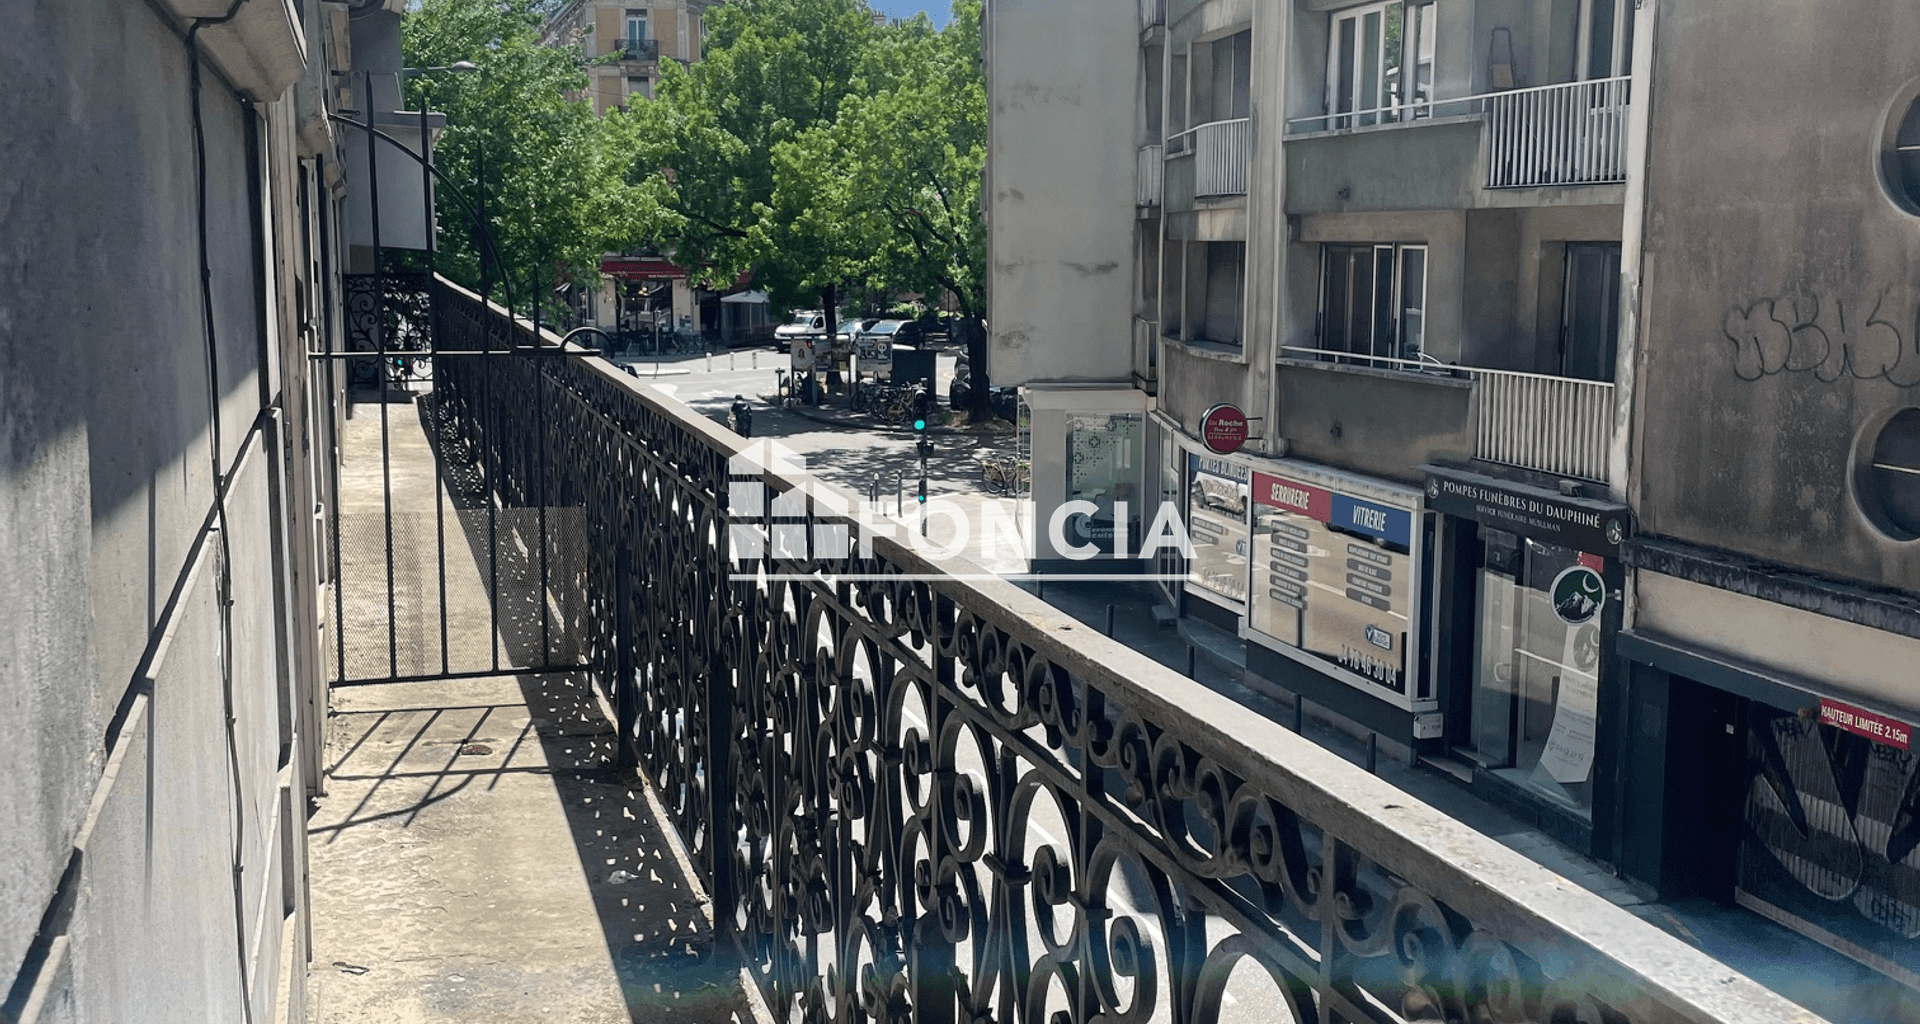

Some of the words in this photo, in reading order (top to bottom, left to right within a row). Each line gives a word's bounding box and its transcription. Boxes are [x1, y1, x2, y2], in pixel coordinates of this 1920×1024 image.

[1219, 419, 1243, 427] Roche
[1270, 482, 1310, 510] SERRURERIE
[1443, 480, 1477, 499] POMPES
[1479, 488, 1526, 510] FUNÈBRES
[1529, 502, 1543, 514] DU
[1546, 504, 1600, 529] DAUPHINÉ
[1352, 504, 1387, 532] VITRERIE
[1821, 705, 1853, 726] HAUTEUR
